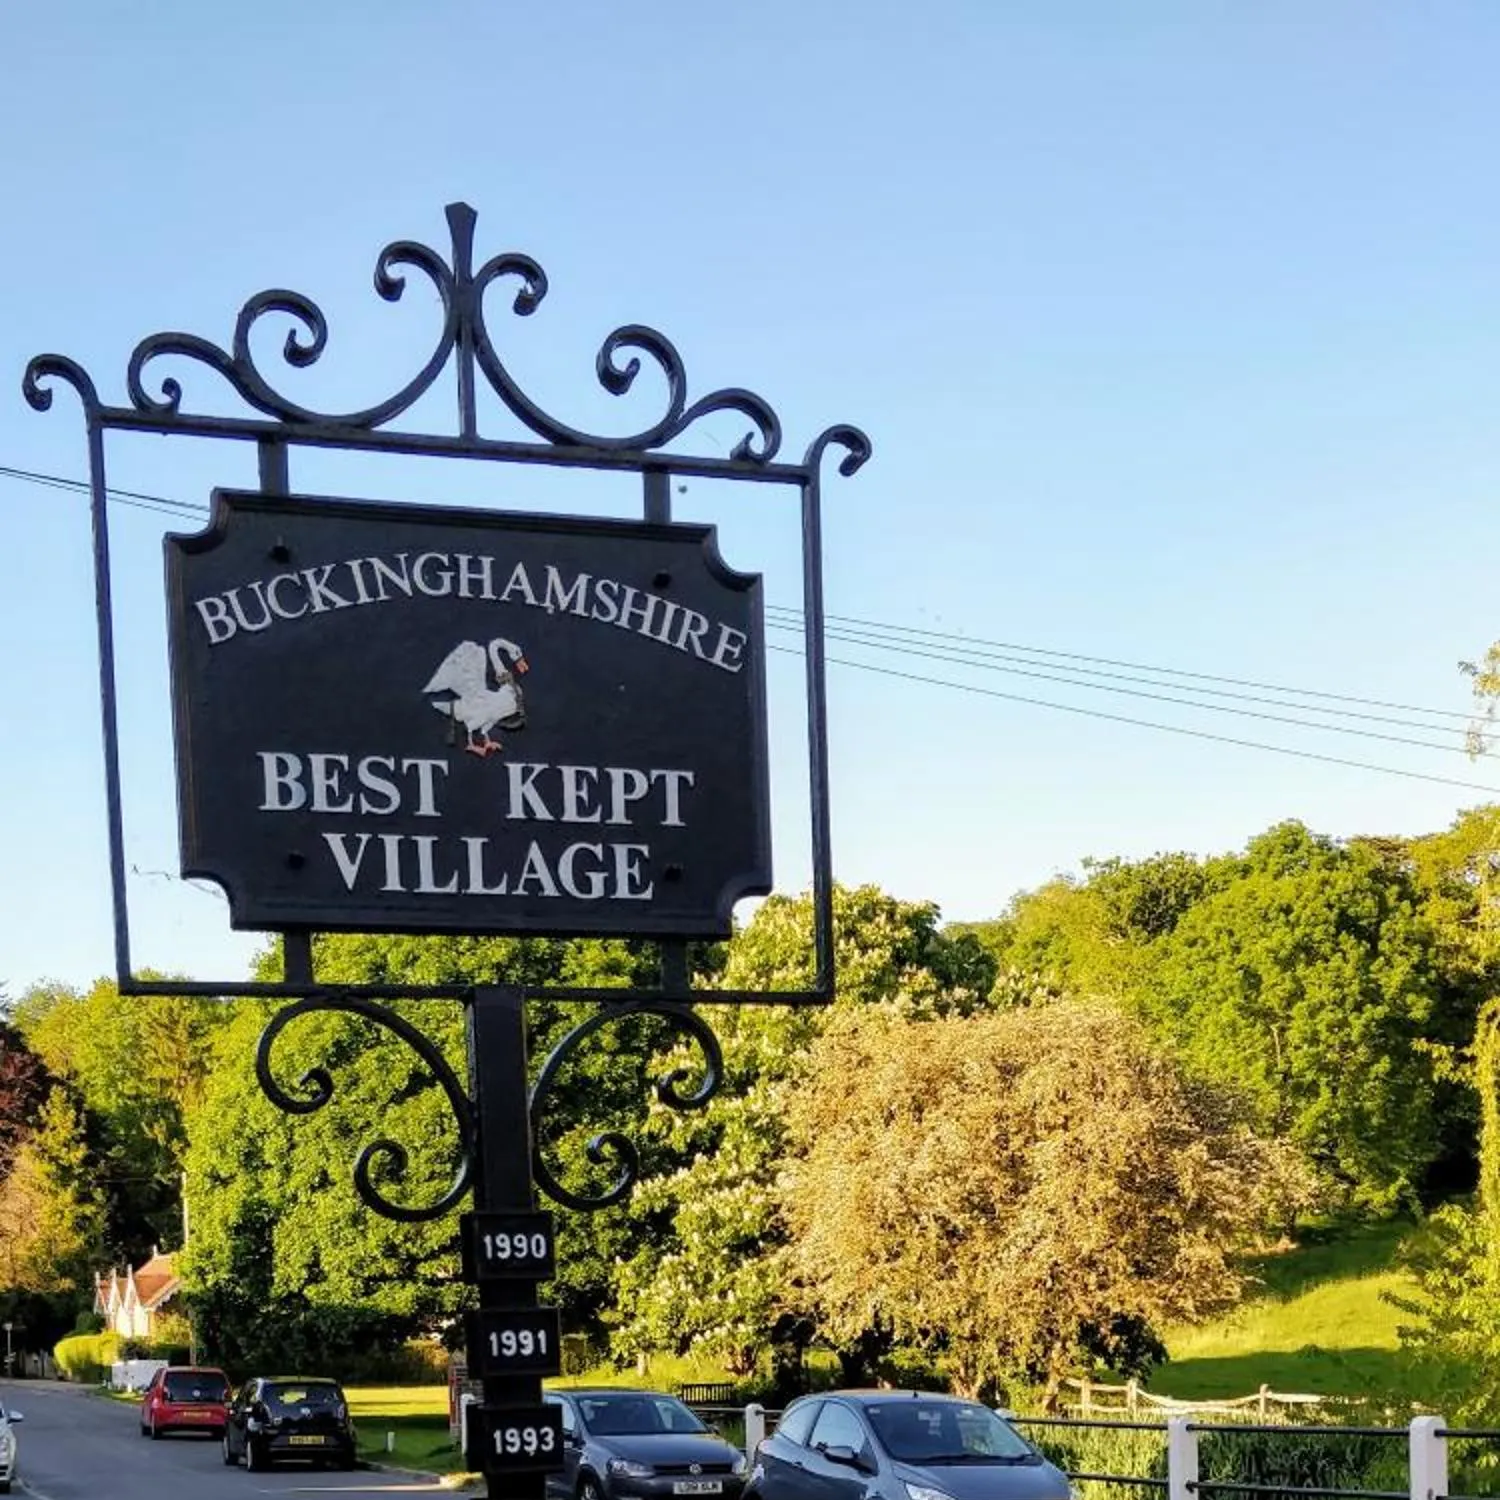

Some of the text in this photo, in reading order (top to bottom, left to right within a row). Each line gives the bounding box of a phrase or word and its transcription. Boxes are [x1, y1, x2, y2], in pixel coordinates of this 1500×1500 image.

[195, 552, 747, 674] BUCKINGHAMSHIRE
[257, 751, 695, 828] BEST KEPT
[322, 833, 654, 900] VILLAGE
[484, 1233, 546, 1260] 1990
[489, 1329, 547, 1357] 1991
[493, 1426, 555, 1454] 1993
